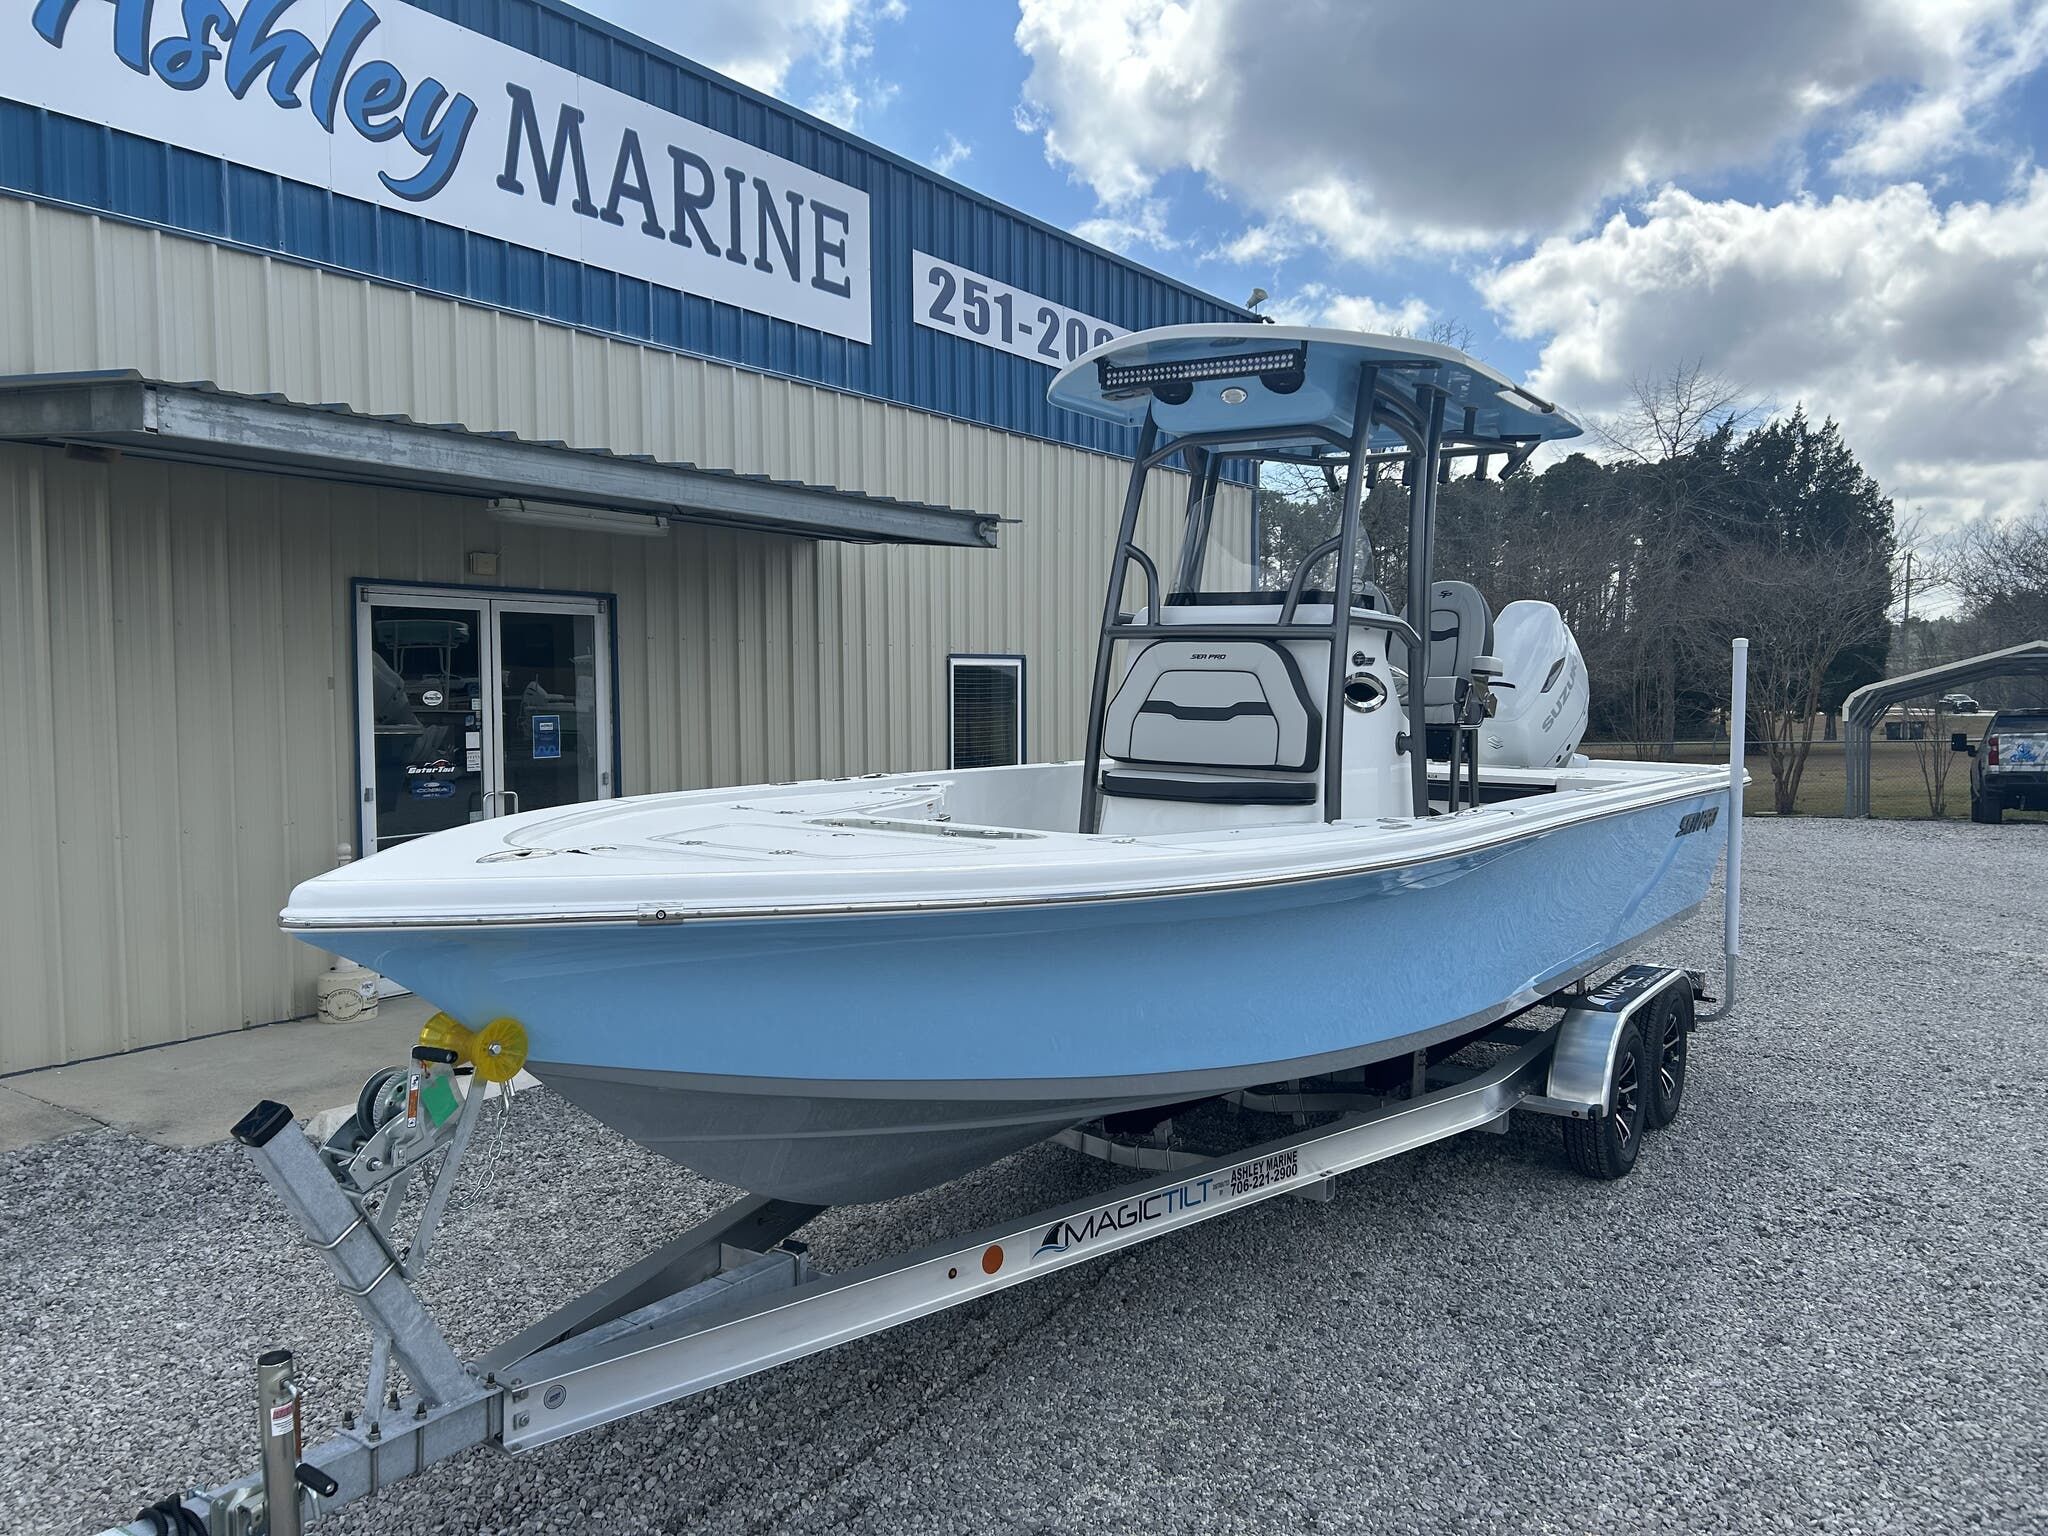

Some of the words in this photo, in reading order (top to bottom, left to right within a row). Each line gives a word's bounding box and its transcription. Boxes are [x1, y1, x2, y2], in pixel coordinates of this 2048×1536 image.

[496, 82, 851, 299] MARINE
[1230, 1163, 1298, 1197] 706-221-2900
[1231, 1160, 1265, 1184] ASHLEY
[1266, 1150, 1298, 1172] MARINE
